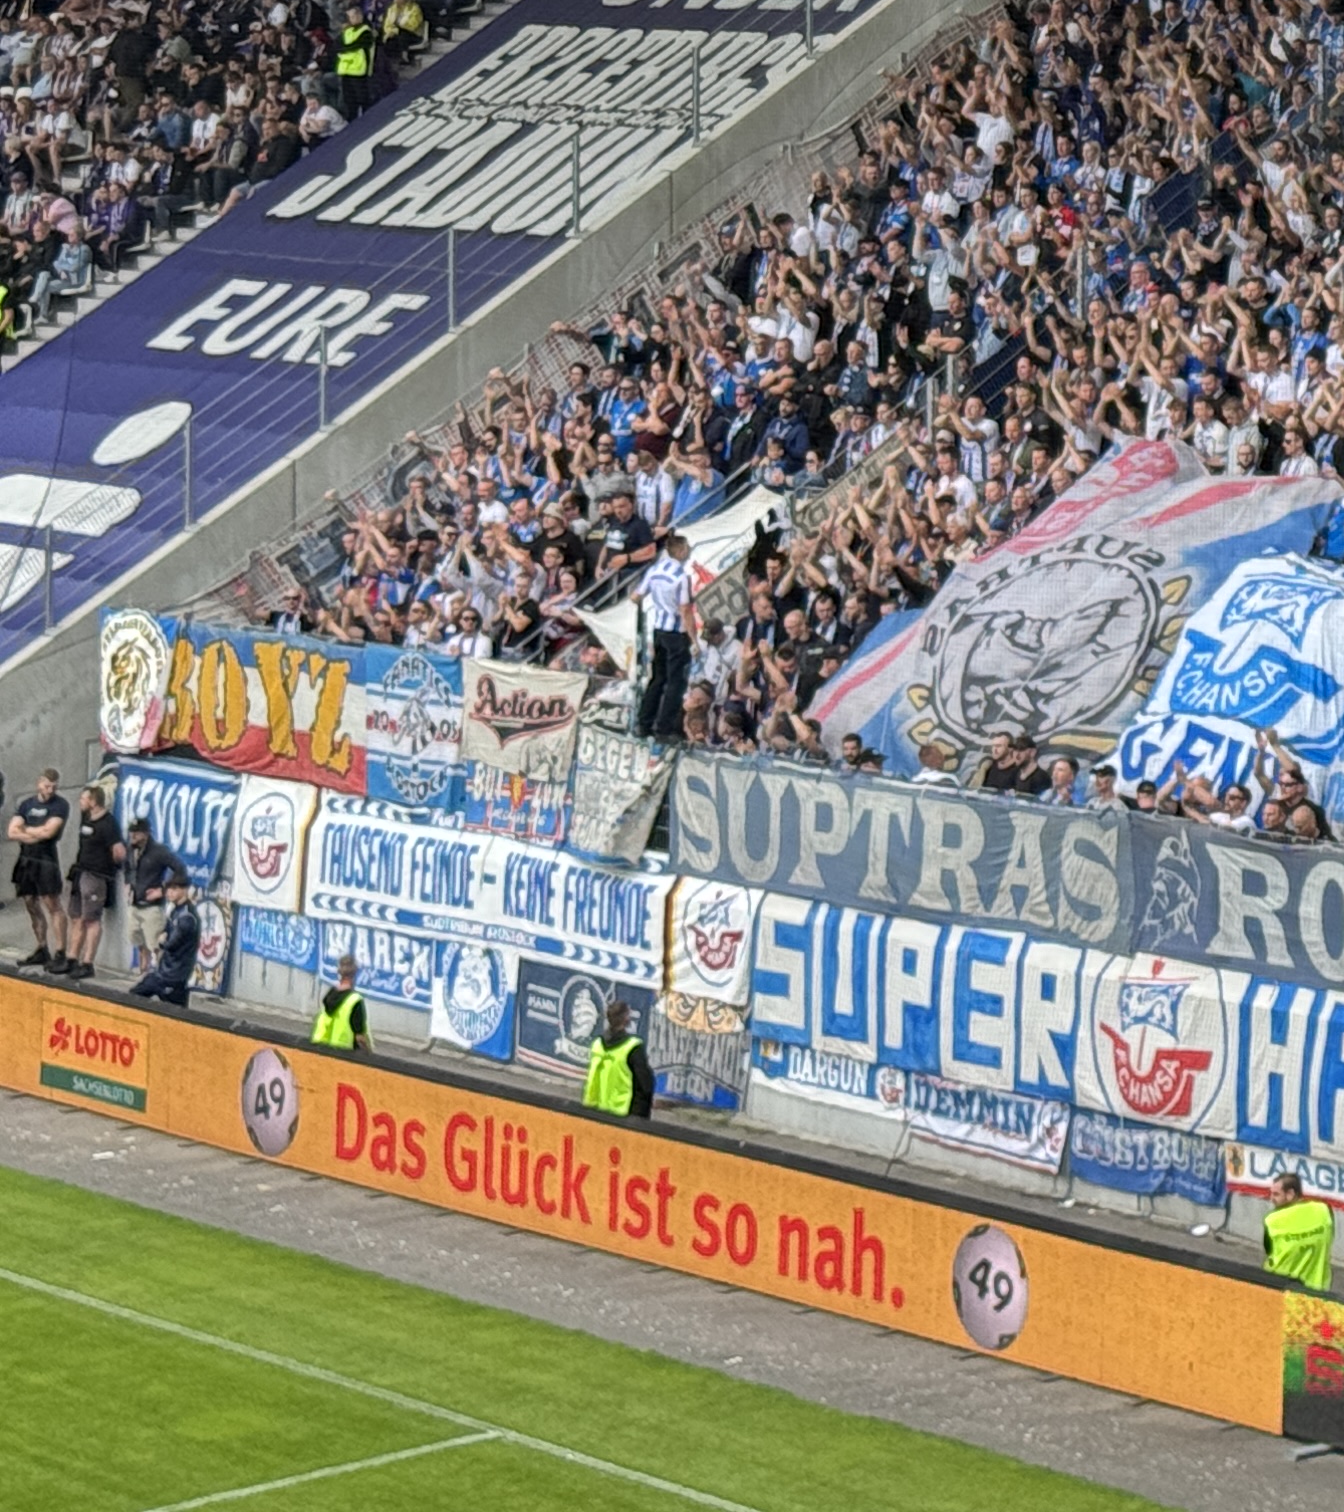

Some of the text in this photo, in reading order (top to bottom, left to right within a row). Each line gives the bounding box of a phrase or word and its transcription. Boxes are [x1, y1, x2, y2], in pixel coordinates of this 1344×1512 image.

[147, 278, 430, 367] EURE
[159, 637, 352, 777] BOYZ
[473, 673, 572, 720] Action
[320, 822, 409, 893] TAUSEND
[410, 835, 481, 910] FEINDE
[503, 851, 560, 927] KEINE
[562, 866, 659, 951] FREUNDE
[674, 753, 1121, 943] SUPTRAS
[752, 890, 1083, 1092] SUPER
[74, 1023, 136, 1068] LOTTO
[786, 1046, 870, 1096] DARGUN
[252, 1076, 287, 1121] 49
[334, 1082, 906, 1309] Das Glück ist so nah.
[967, 1256, 1015, 1313] 49
